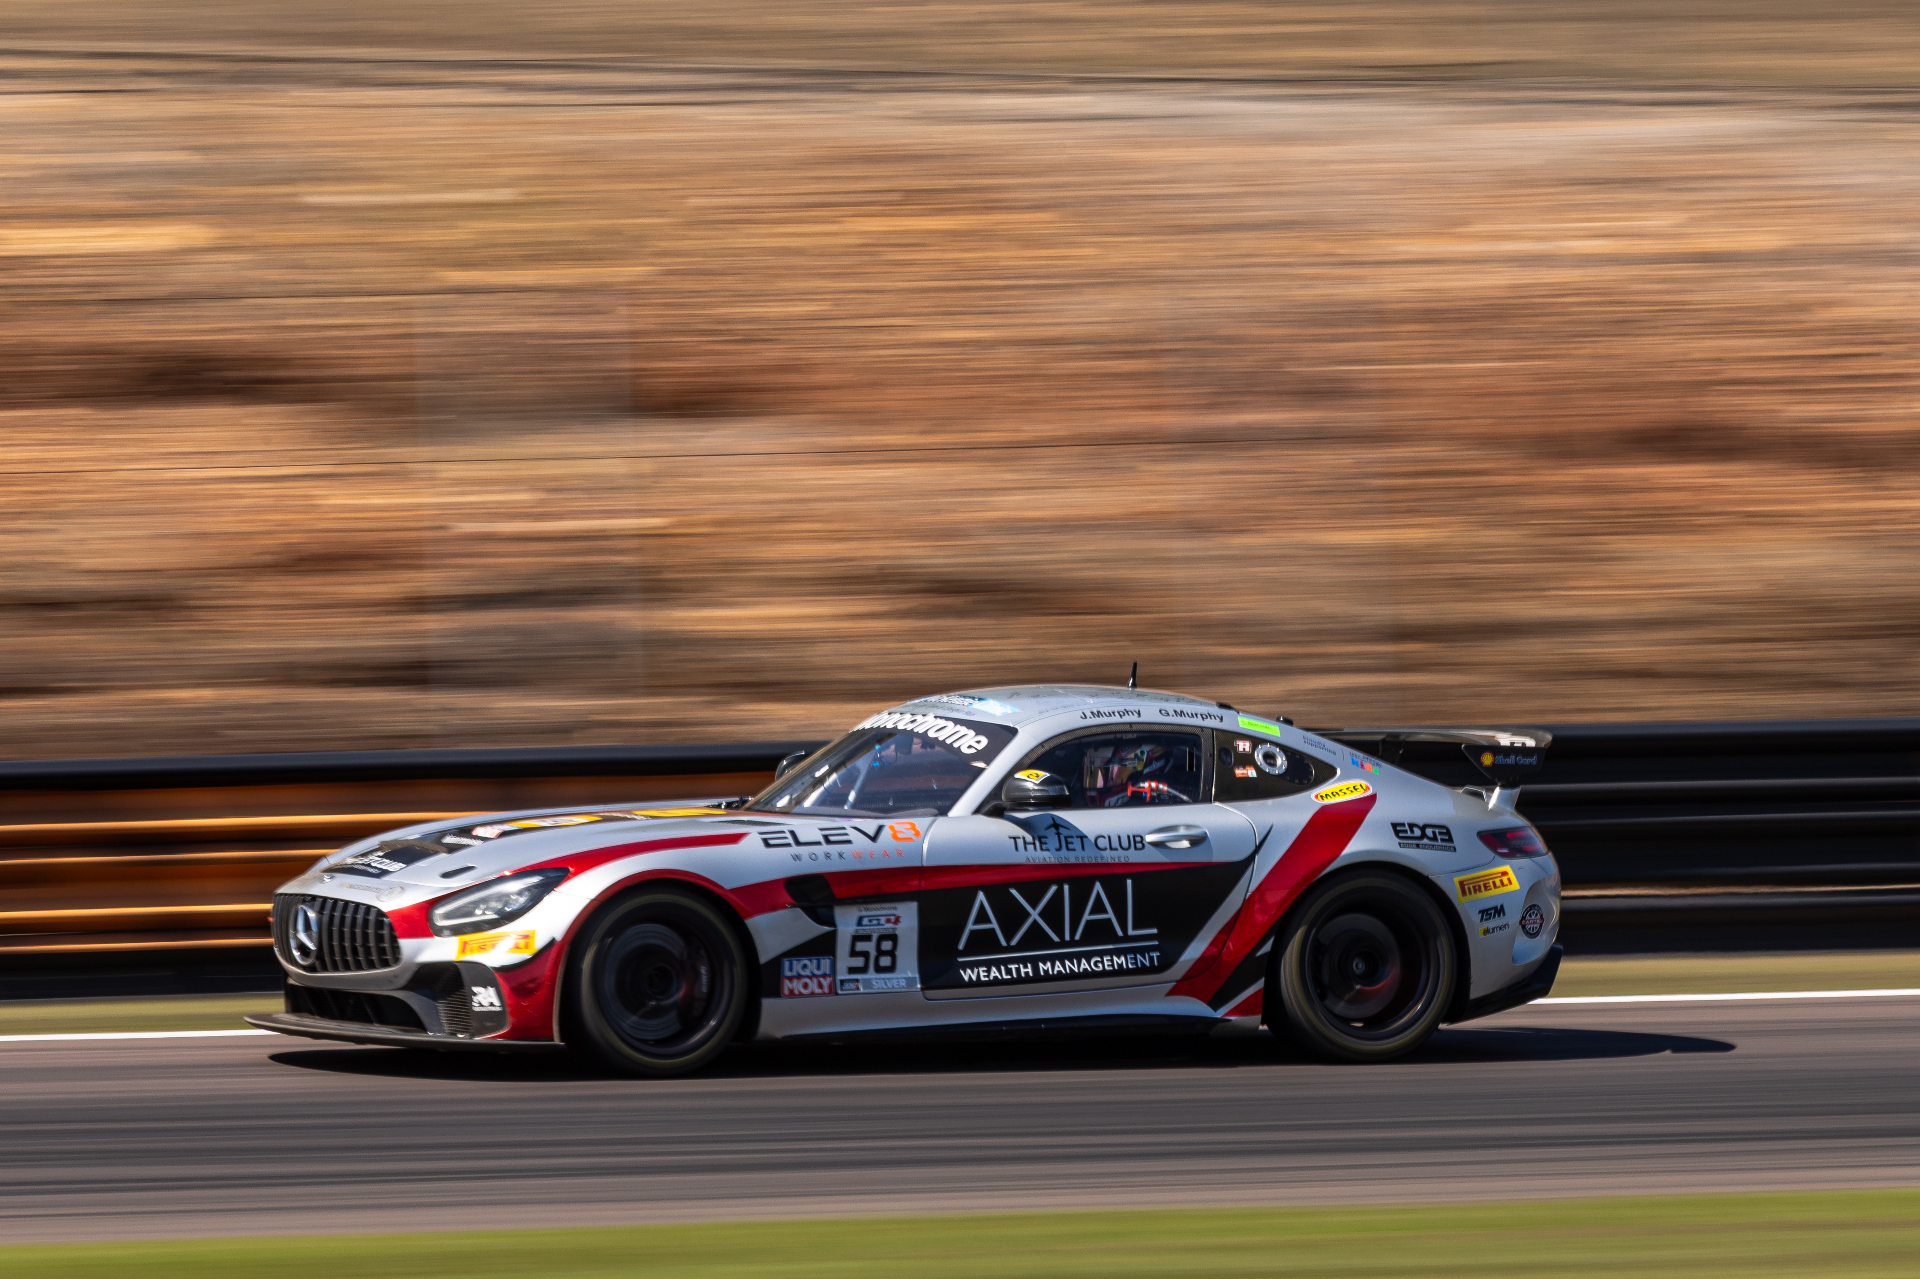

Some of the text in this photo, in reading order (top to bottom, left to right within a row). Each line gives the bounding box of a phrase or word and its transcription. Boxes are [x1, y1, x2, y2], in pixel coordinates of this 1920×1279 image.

[1079, 708, 1224, 723] J.Murphy G.Murphy
[1495, 754, 1537, 765] Shell Card
[1319, 784, 1367, 801] MASSEL
[757, 820, 922, 849] ELEV8
[1008, 833, 1146, 852] THE JET CLUB
[1391, 822, 1455, 844] EDGE
[1025, 855, 1130, 864] AVIATION REDEFINED
[1458, 870, 1513, 898] PIRELLI
[957, 878, 1158, 951] AXIAL
[1478, 904, 1506, 923] TSM
[461, 934, 531, 955] PIRELI
[847, 933, 898, 975] 58
[783, 958, 831, 976] LIQUI
[959, 951, 1161, 983] WEALTH MANAGEMENT
[783, 977, 833, 996] MOLY
[872, 978, 907, 989] SILVER
